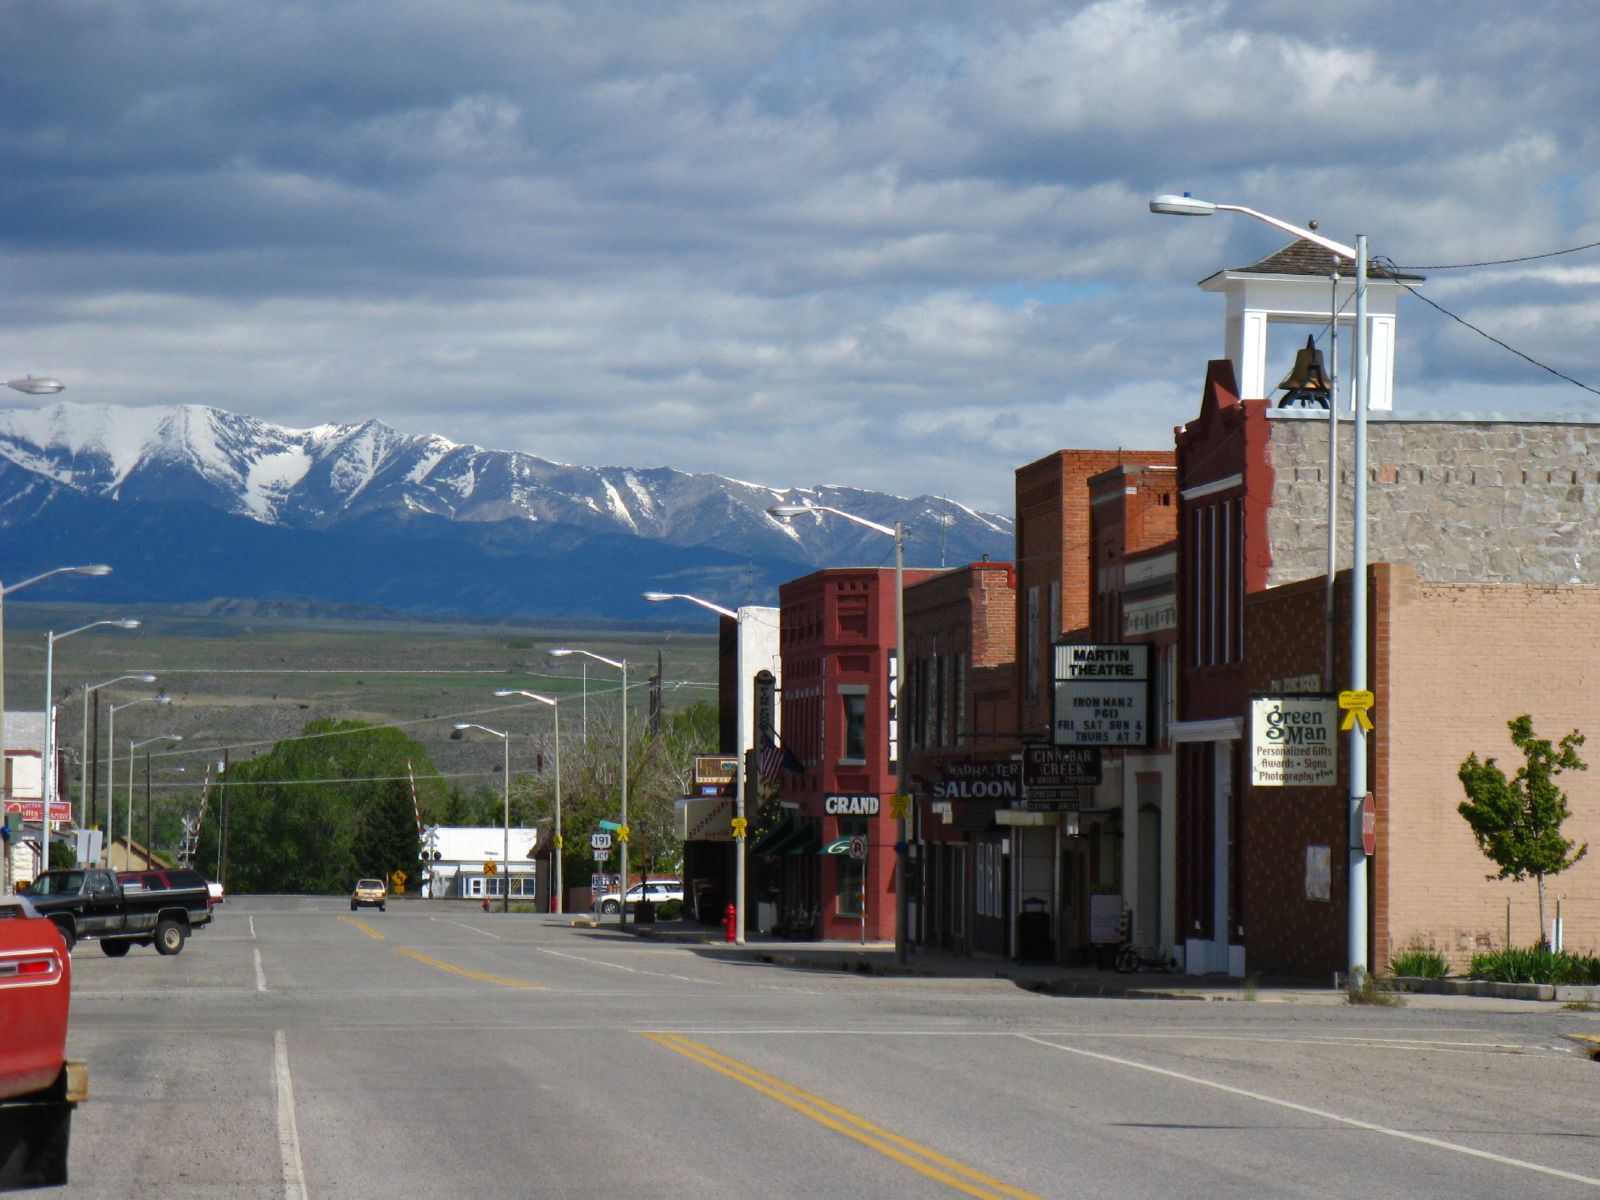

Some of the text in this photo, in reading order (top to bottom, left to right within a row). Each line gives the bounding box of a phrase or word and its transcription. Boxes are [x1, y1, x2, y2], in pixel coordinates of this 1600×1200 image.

[1074, 650, 1129, 661] MARTIN
[1069, 664, 1134, 676] THEATRE
[1073, 697, 1133, 708] IRON MAN 2
[1095, 709, 1119, 718] PG13
[1057, 720, 1074, 730] FRI
[1083, 720, 1103, 730] SAT
[1109, 720, 1130, 730] SUN
[1075, 731, 1142, 742] THURS AT 7
[1284, 726, 1327, 745] Man
[1256, 746, 1332, 756] Personalized Gifts
[1043, 763, 1085, 776] CREEK
[1261, 758, 1328, 770] Awards Signs
[1259, 771, 1314, 783] Photography
[932, 780, 1017, 799] SALOON
[825, 796, 879, 815] GRAND
[594, 836, 609, 846] 191
